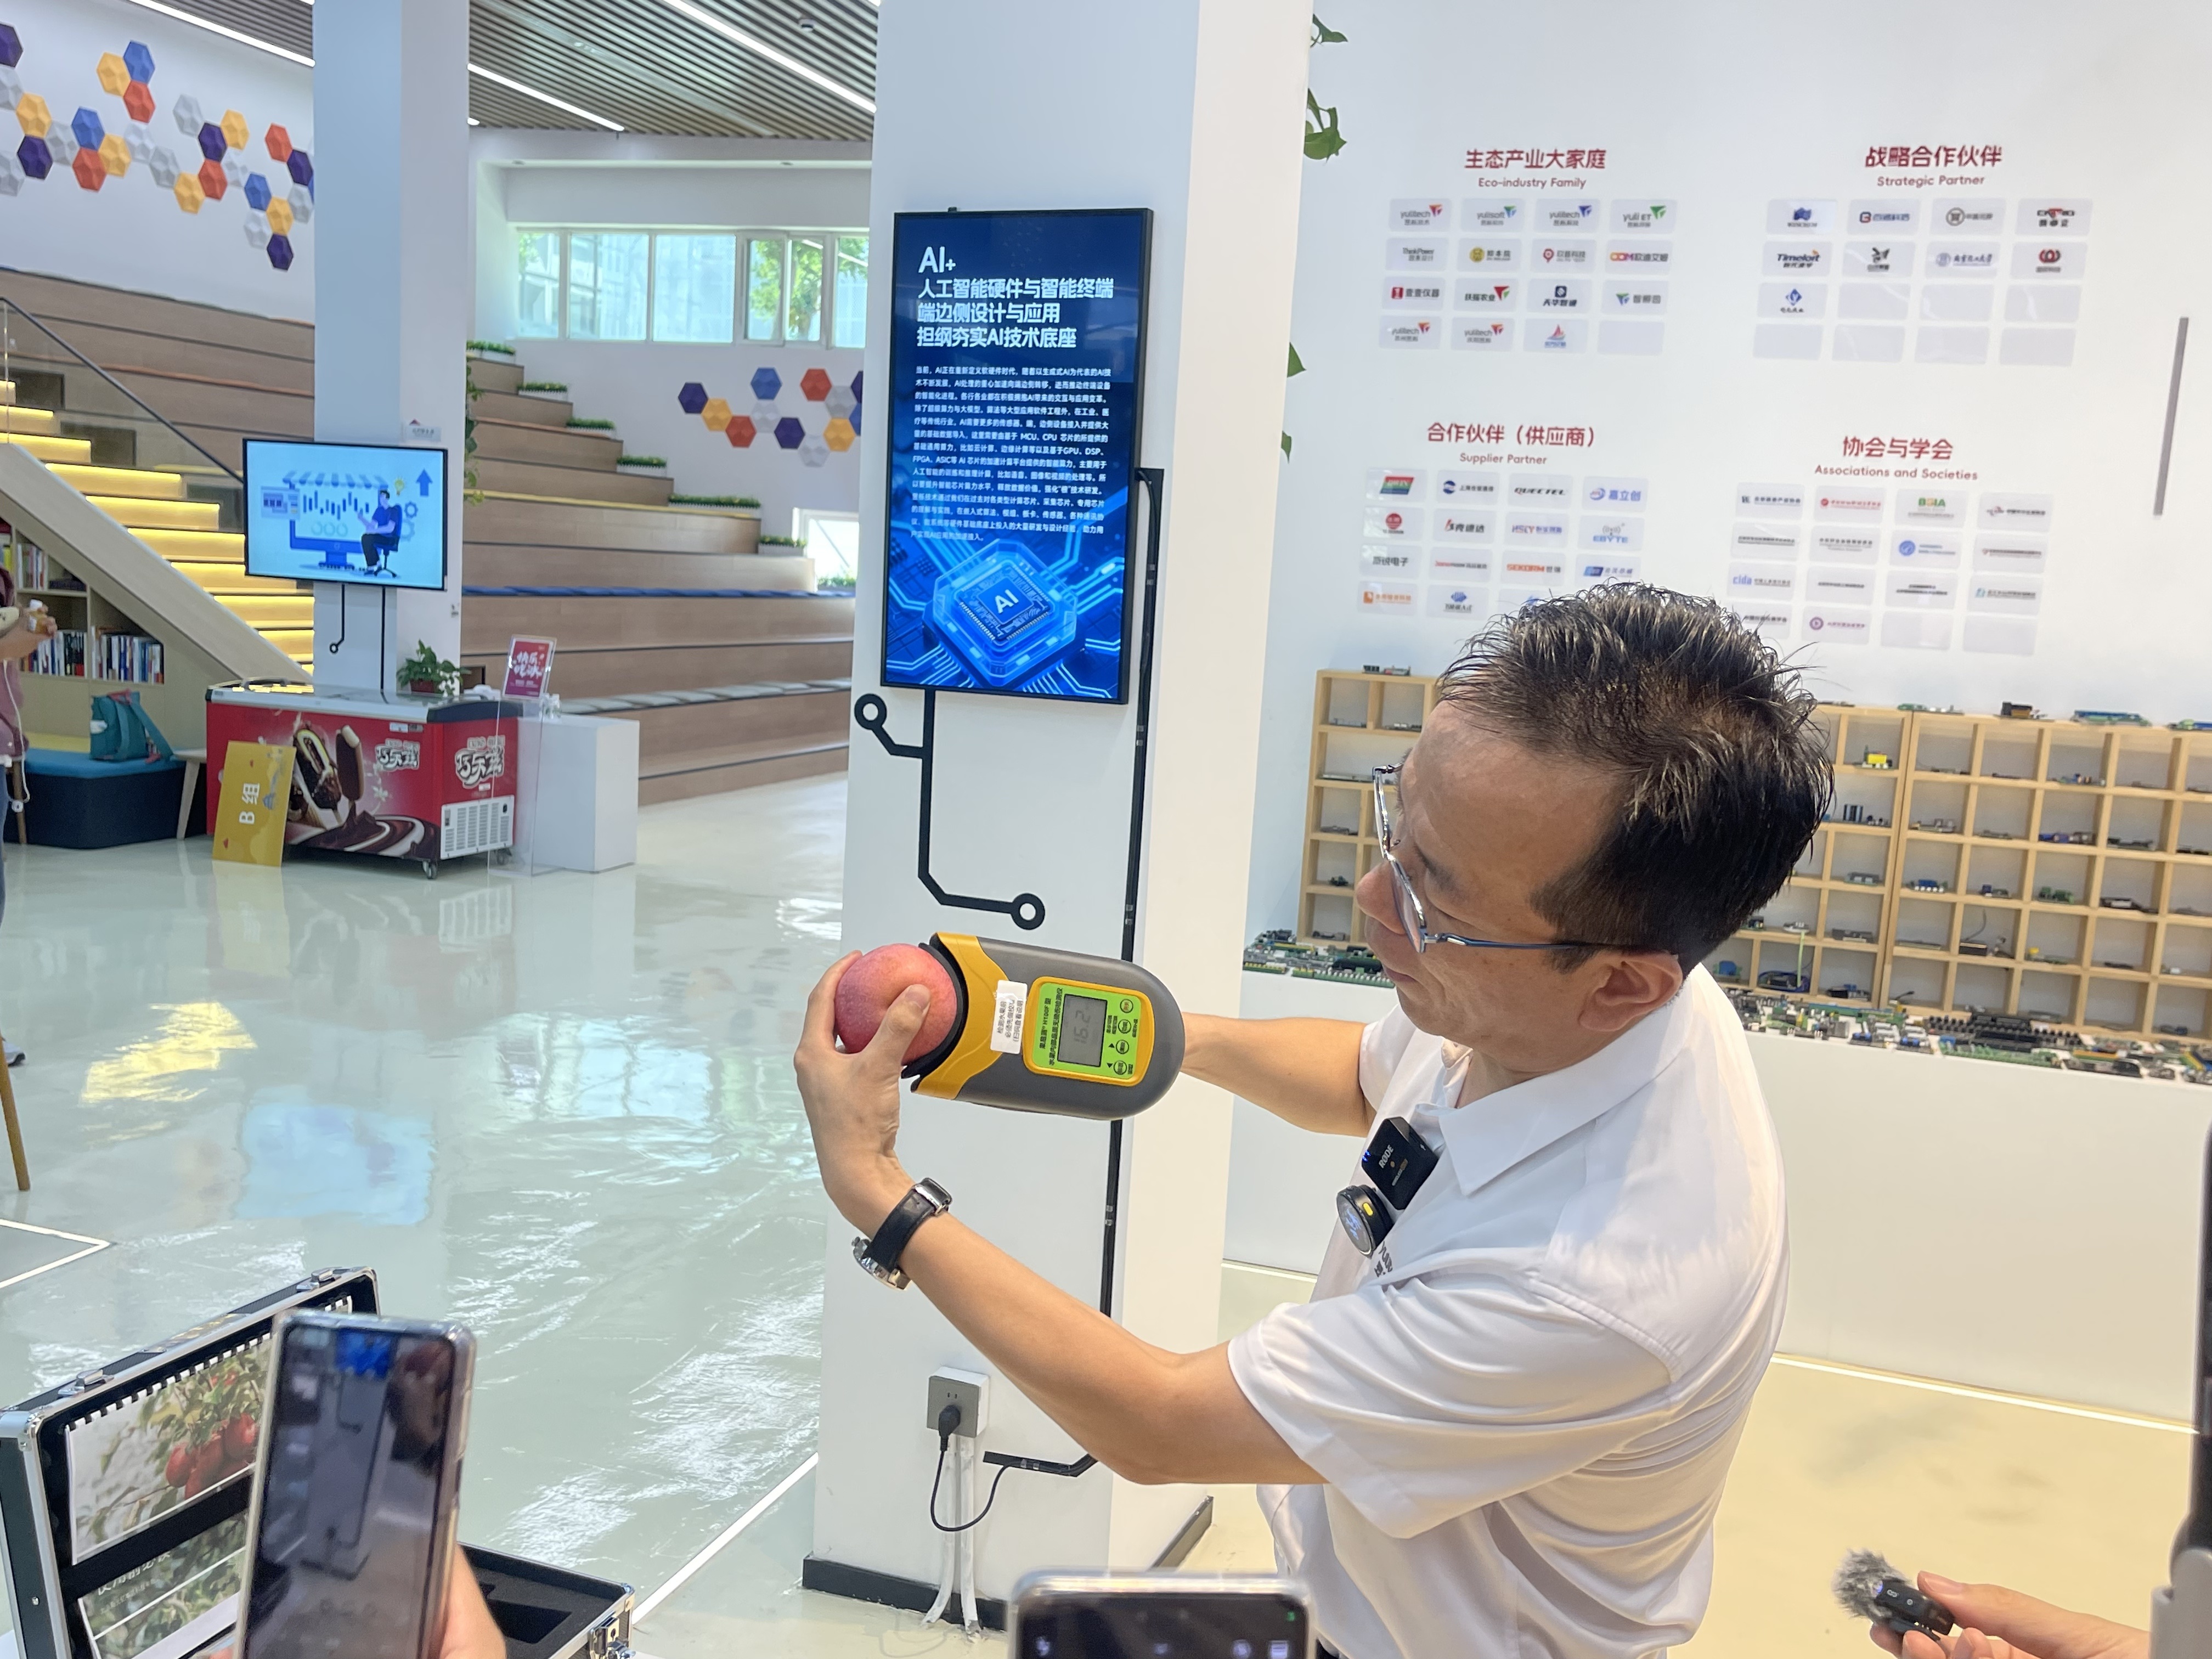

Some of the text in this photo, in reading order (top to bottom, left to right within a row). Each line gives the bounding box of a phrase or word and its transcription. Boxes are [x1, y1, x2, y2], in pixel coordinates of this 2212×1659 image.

[1464, 149, 1607, 170] 生态产业大家庭
[1865, 145, 2002, 168] 战略合作伙伴
[1478, 177, 1587, 189] Eco-industry Family
[1877, 174, 1985, 188] Strategic Partner
[918, 246, 956, 273] AI+
[918, 278, 1114, 299] 人工智能硬件与智能终端
[917, 302, 1060, 323] 端边侧设计与应用
[917, 326, 1076, 348] 担纲夯实AI技术底座
[1427, 422, 1595, 447] 合作伙伴（供应商）
[1459, 452, 1548, 465] Supplier Partner
[1843, 436, 1953, 460] 协会与学会
[1814, 464, 1978, 481] Associations and Societies
[995, 588, 1019, 614] AI
[239, 782, 261, 825] B 组
